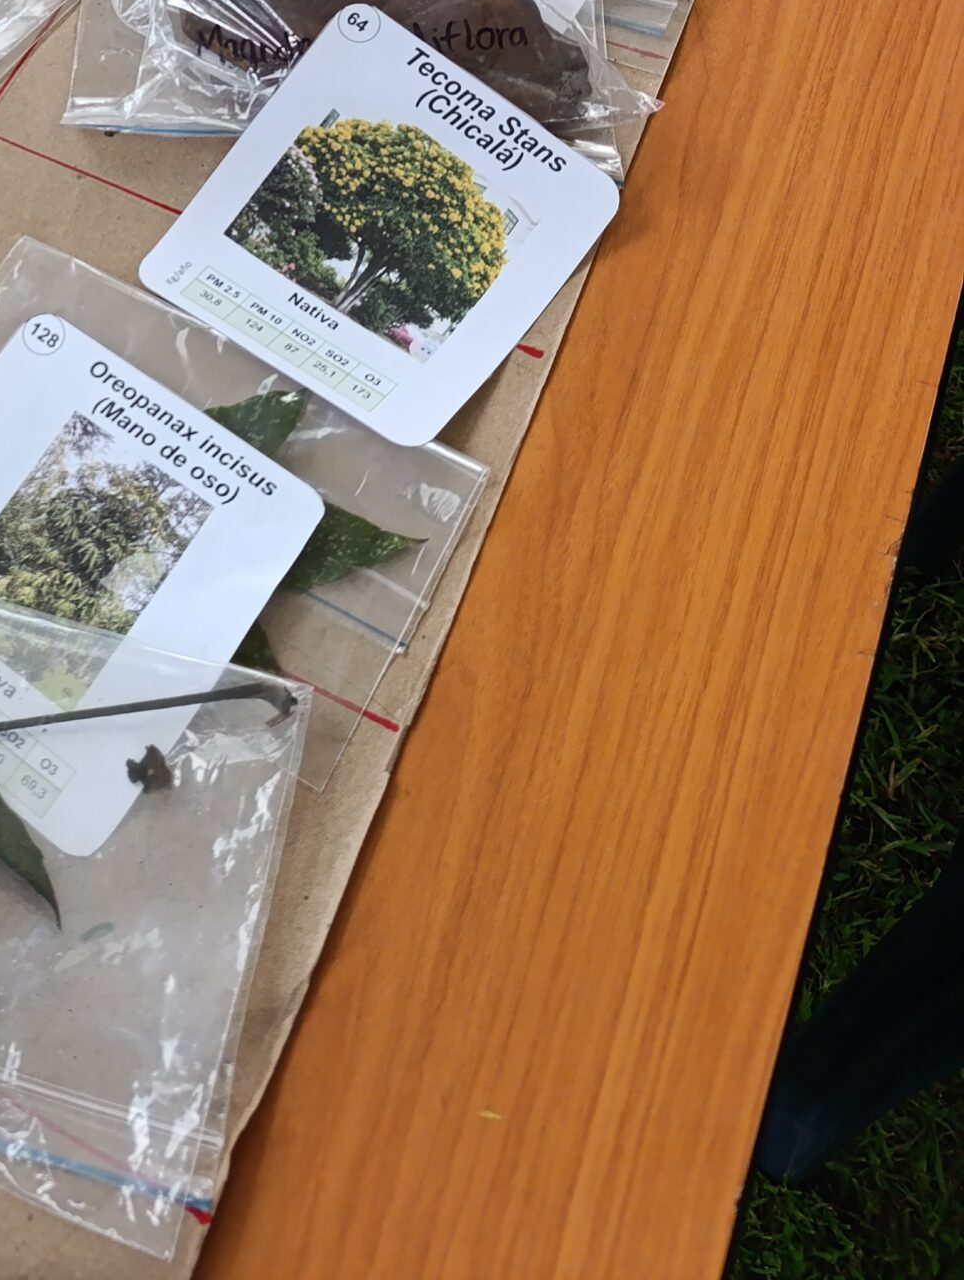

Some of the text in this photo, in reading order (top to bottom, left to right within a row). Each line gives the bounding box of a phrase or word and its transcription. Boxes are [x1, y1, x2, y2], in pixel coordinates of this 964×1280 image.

[347, 12, 369, 32] 64
[405, 47, 568, 173] Tecoma Stans
[415, 89, 525, 173] (Chicalá)
[206, 273, 242, 300] PM 2.5
[199, 290, 223, 307] 30,8
[250, 302, 284, 325] PM 10
[288, 292, 340, 331] Nativa
[30, 323, 60, 348] 128
[244, 318, 264, 333] 124
[291, 328, 317, 347] NO2
[284, 343, 300, 355] 87
[325, 348, 350, 368] SO2
[312, 361, 337, 379] 25,1
[364, 373, 383, 388] O3
[350, 384, 372, 400] 173
[90, 361, 278, 497] Oreopanax incisus
[91, 398, 240, 505] (Mano de oso)
[40, 758, 59, 776] O3
[20, 774, 49, 800] 69,3
